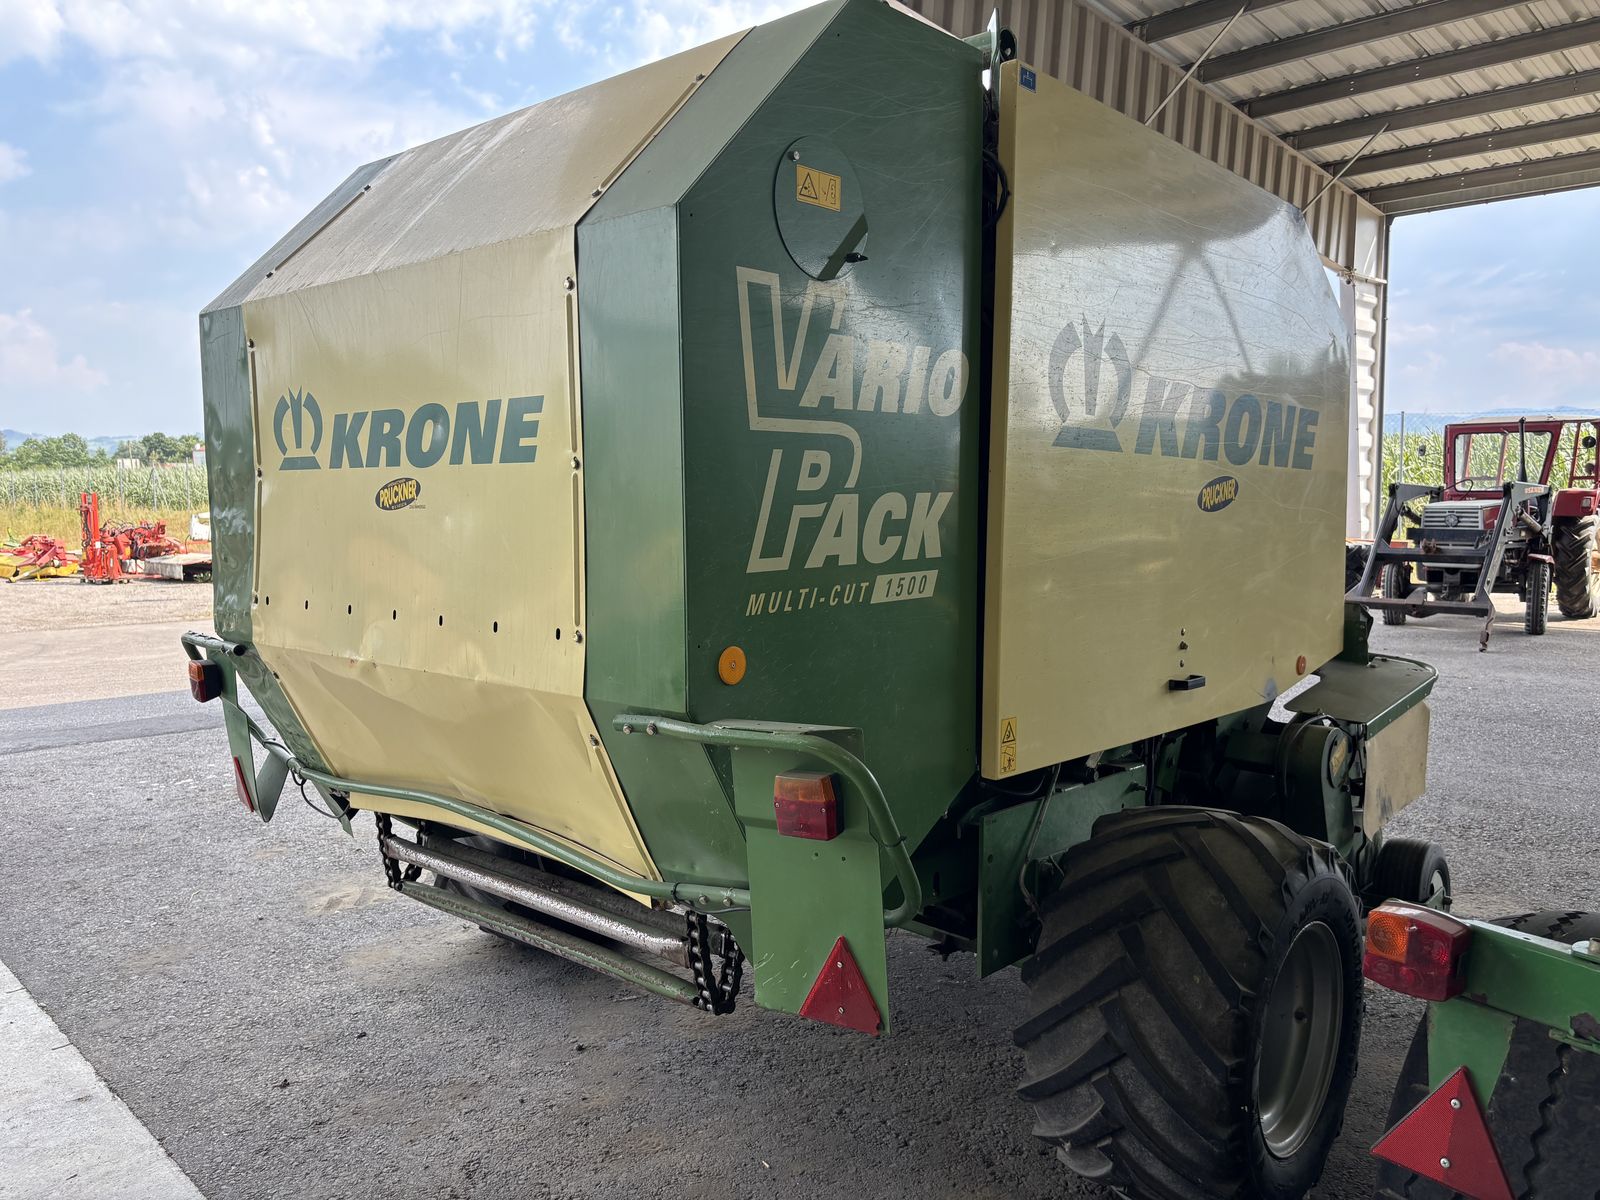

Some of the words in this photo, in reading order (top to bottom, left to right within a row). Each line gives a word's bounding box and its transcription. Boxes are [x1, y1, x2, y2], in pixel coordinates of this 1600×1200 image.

[736, 265, 969, 424] VARIO
[329, 395, 545, 469] KRONE
[1134, 377, 1320, 471] KRONE
[379, 479, 418, 509] PRUCKNER
[746, 422, 954, 574] PACK
[1201, 478, 1236, 510] PRUCKNER
[745, 581, 870, 617] MULTI-CUT
[884, 573, 929, 599] 1500
